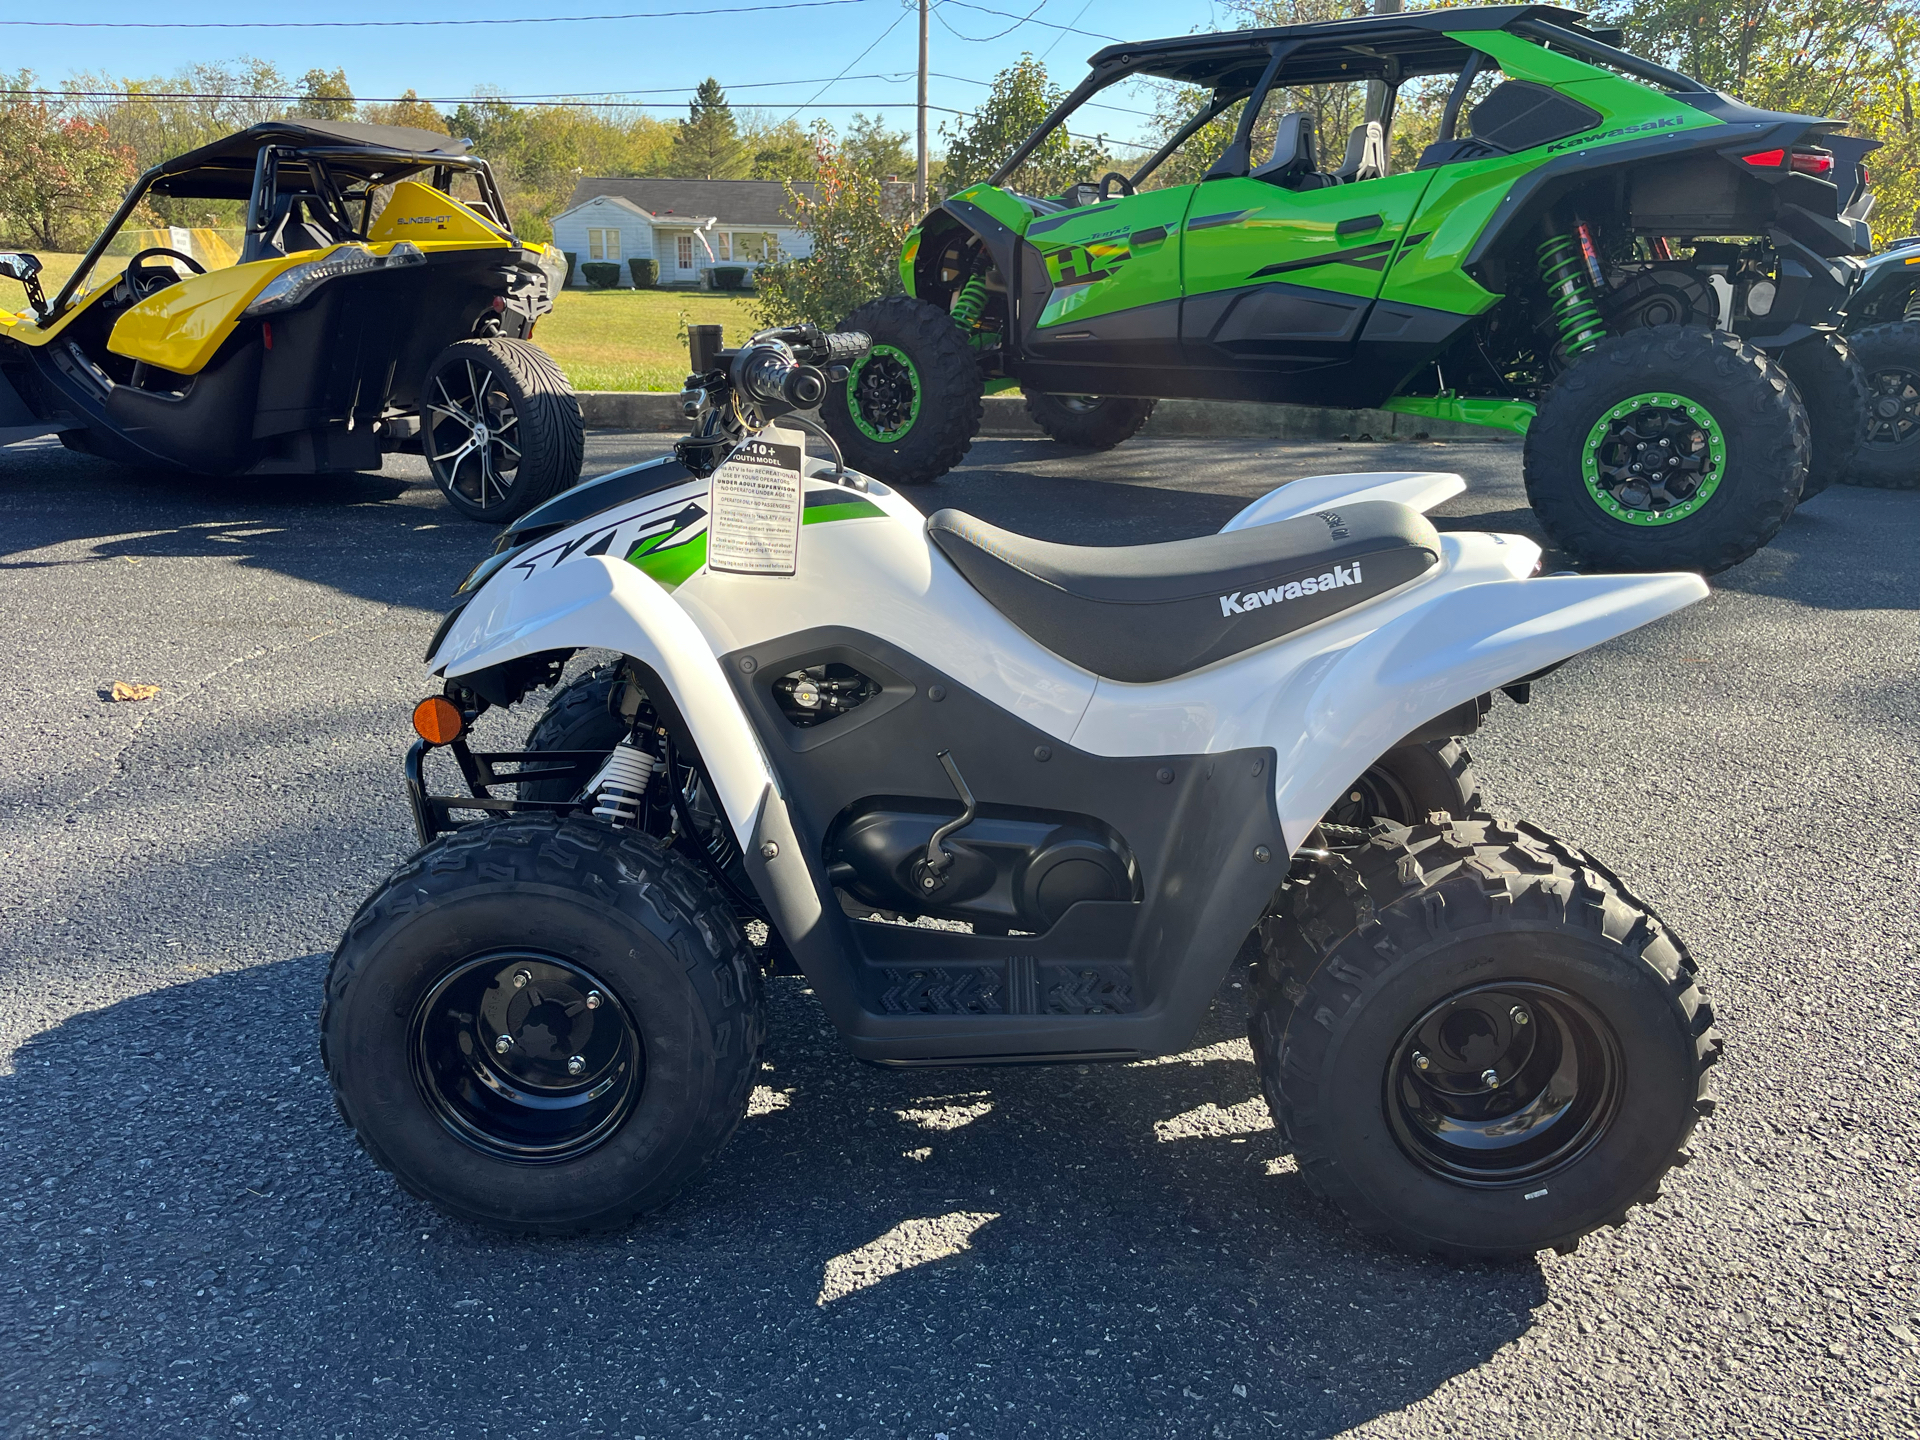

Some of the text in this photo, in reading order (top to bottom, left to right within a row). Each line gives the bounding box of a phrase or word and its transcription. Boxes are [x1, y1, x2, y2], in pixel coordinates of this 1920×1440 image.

[1547, 115, 1684, 153] Kawasaki
[397, 215, 452, 225] SLINGSHOT
[1045, 237, 1132, 283] H2
[756, 456, 782, 466] MODEL
[755, 469, 797, 480] RECREATIONAL
[760, 476, 790, 485] OPERATORS
[1219, 561, 1362, 617] Kawasaki
